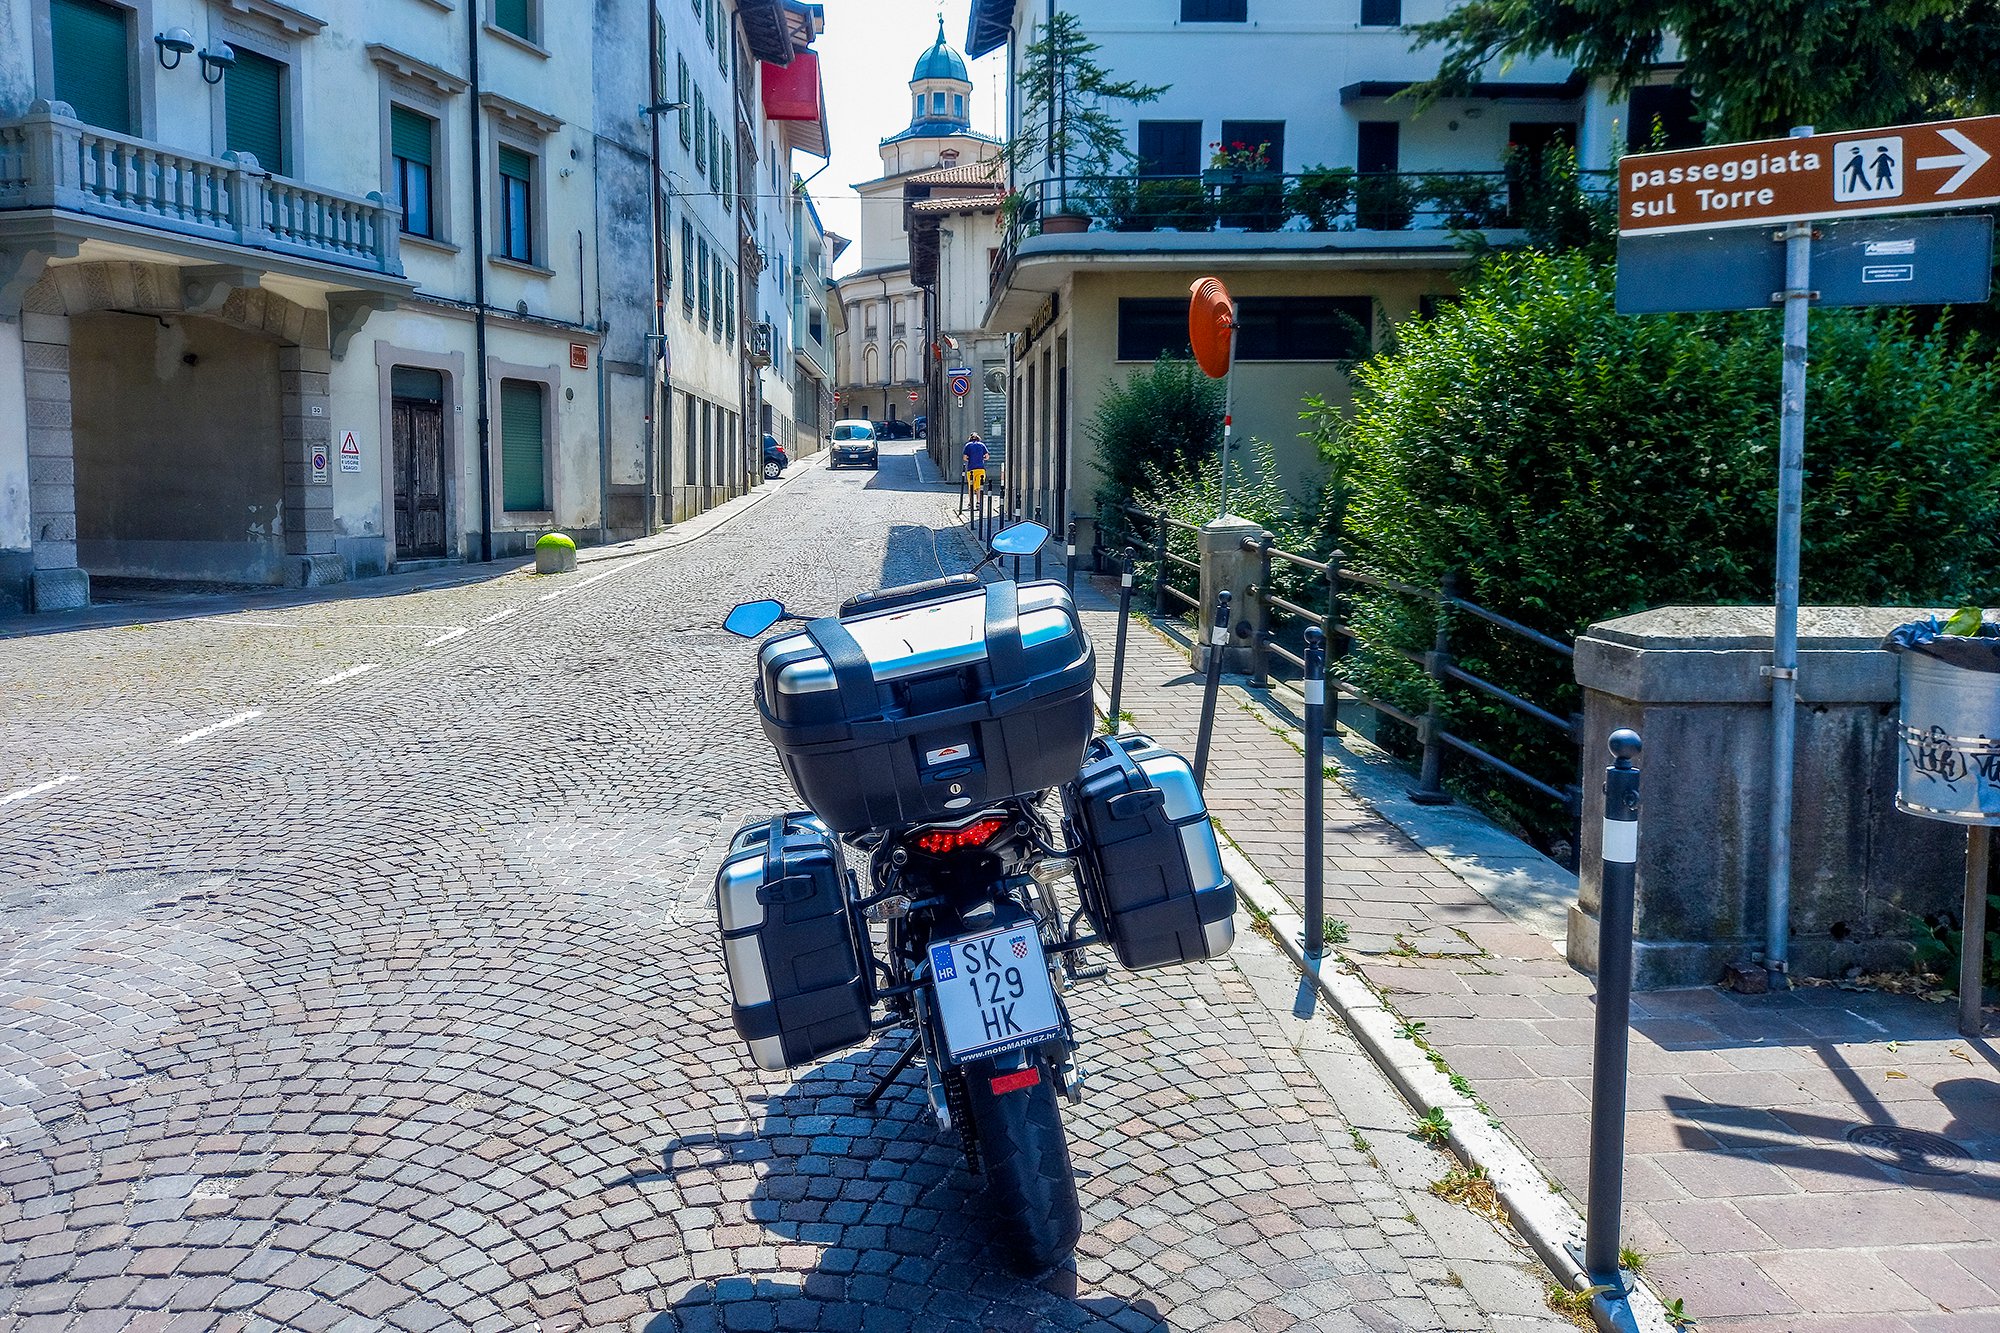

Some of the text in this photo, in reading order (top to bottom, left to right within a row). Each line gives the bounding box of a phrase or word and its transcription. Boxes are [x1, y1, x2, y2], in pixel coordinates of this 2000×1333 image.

[1630, 149, 1821, 192] passeggiata
[1630, 187, 1774, 218] sul Torre
[938, 967, 955, 980] HR
[962, 937, 1002, 974] SK
[969, 966, 1025, 1007] 129
[981, 1002, 1022, 1040] HK
[960, 1031, 1056, 1062] www.motoMARKEZ.hr
